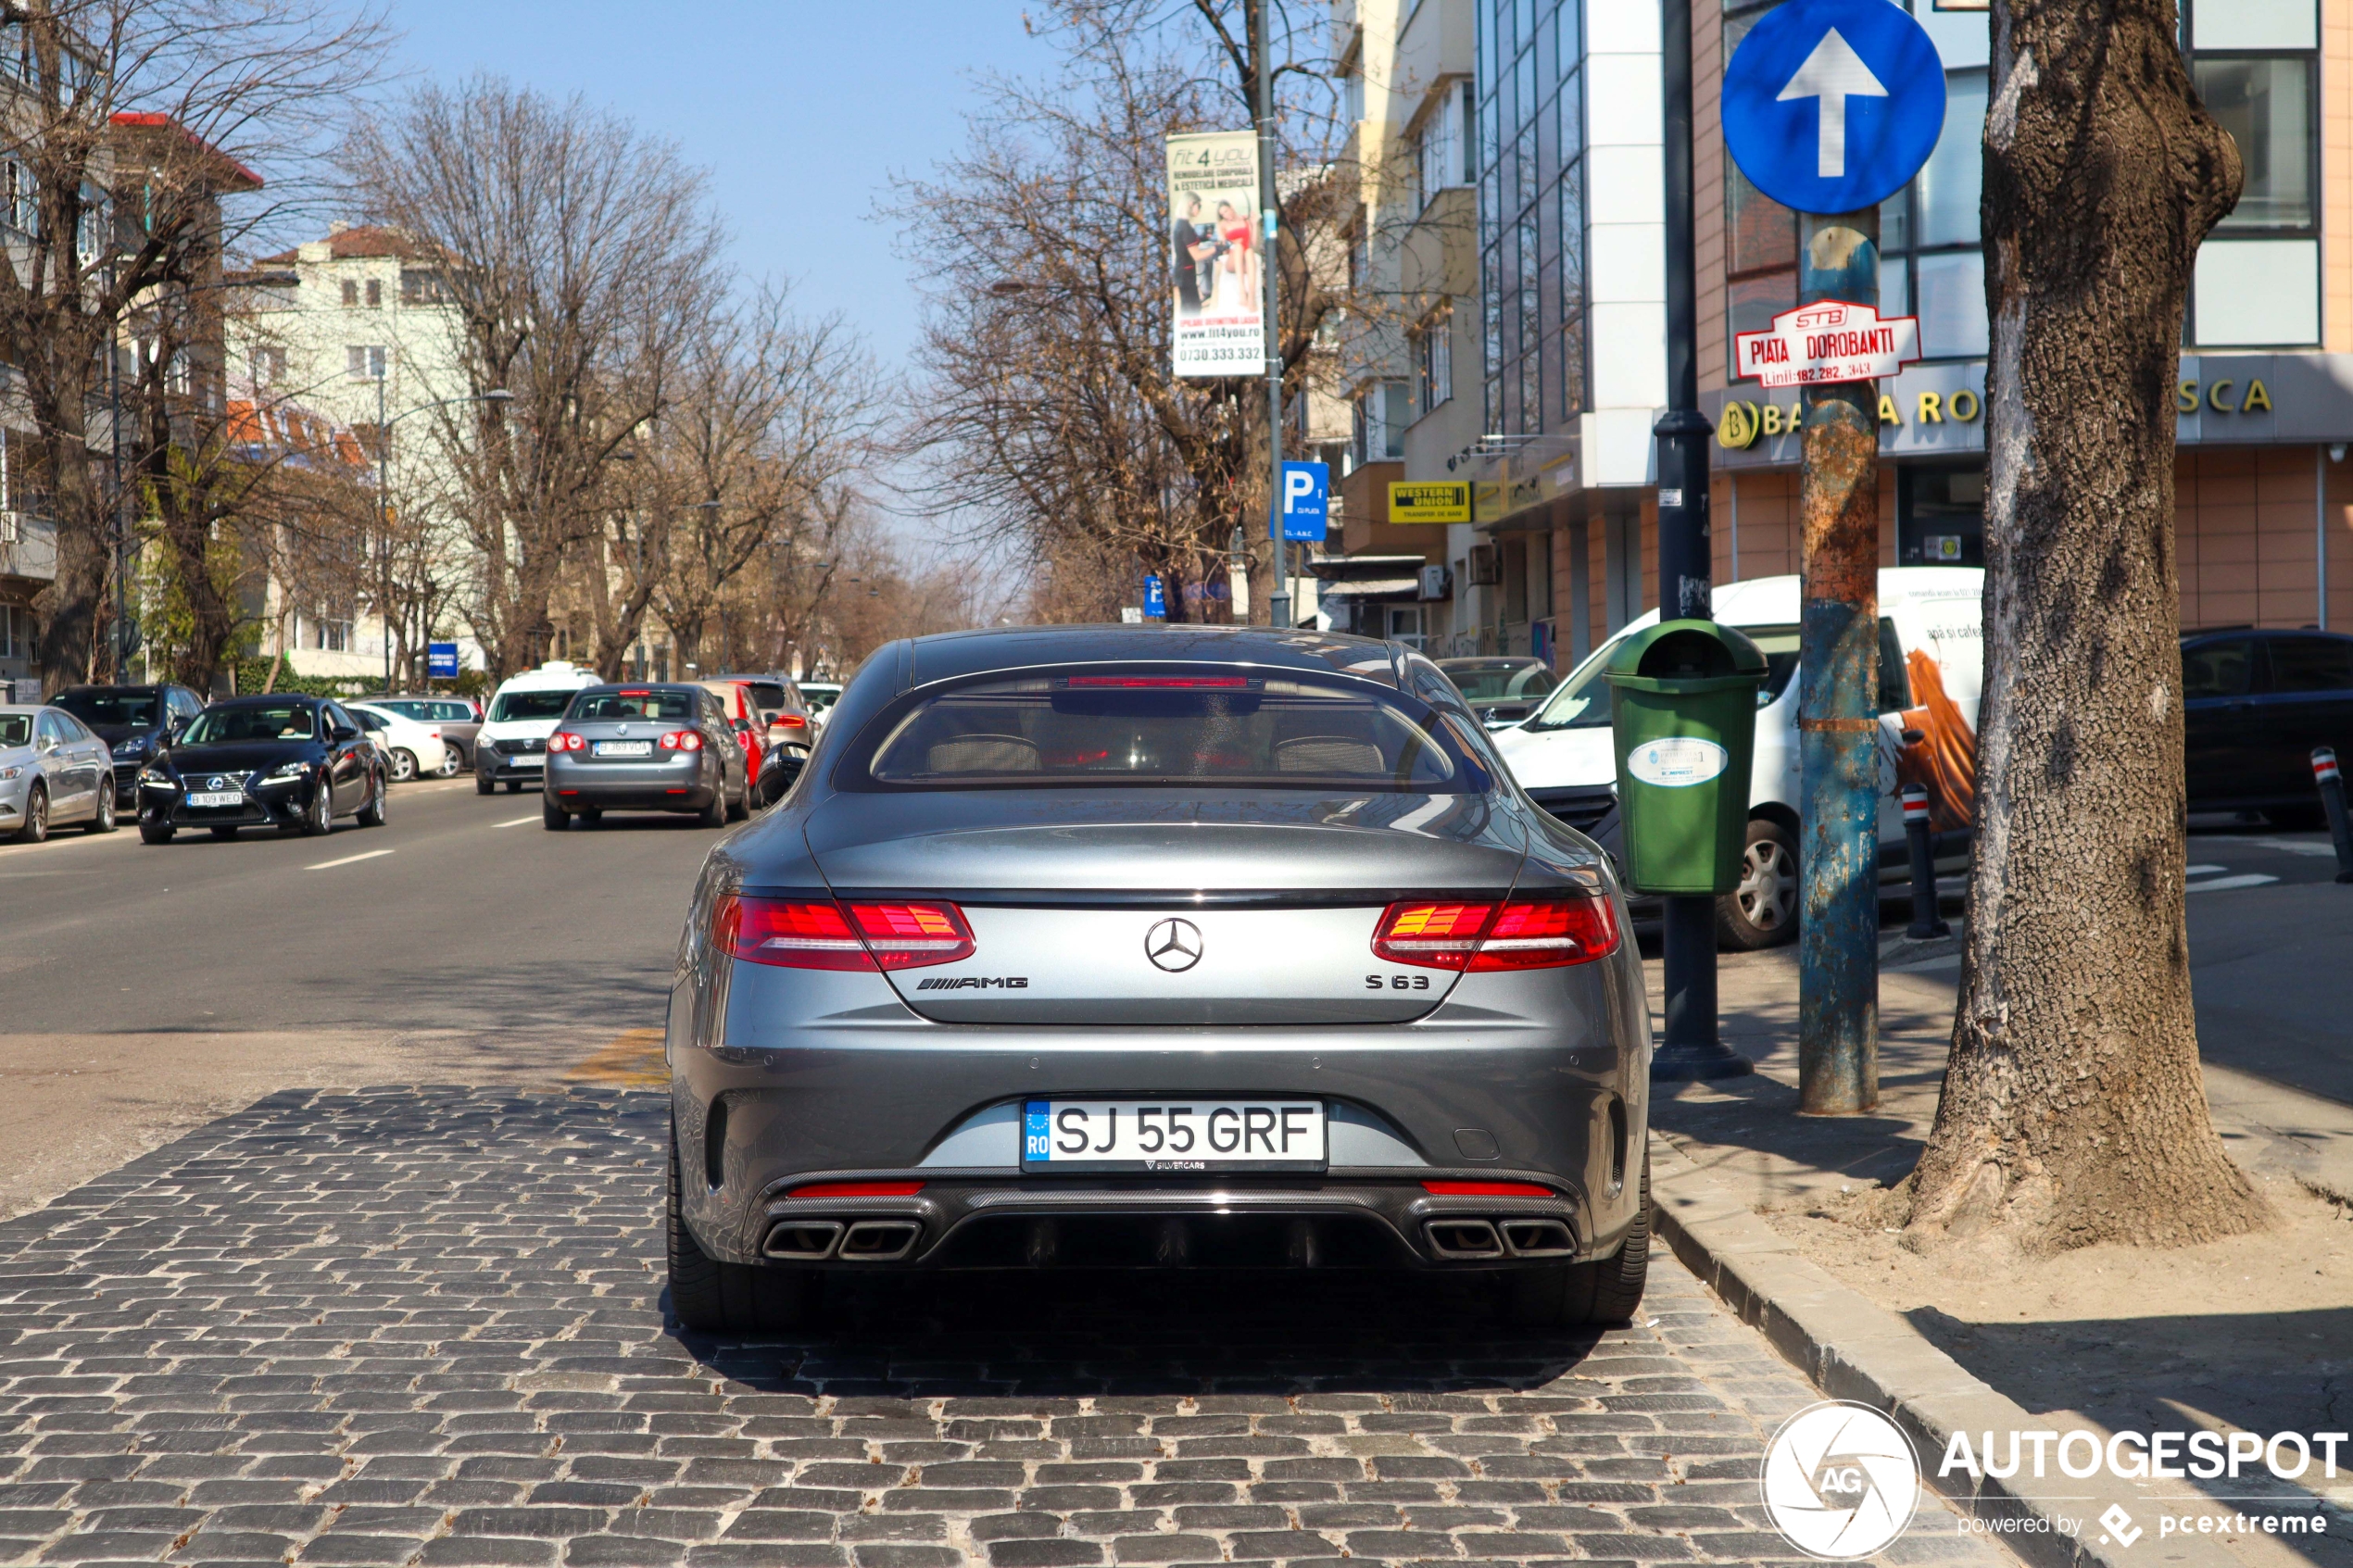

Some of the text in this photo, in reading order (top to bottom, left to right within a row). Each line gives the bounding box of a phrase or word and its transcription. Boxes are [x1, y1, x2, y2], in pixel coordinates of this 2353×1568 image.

[1173, 148, 1253, 167] fit 4 you
[1174, 169, 1214, 179] REMODELARE
[1795, 310, 1843, 328] STB
[1180, 327, 1260, 339] www.fit4you.ro
[1180, 347, 1260, 361] 0730.333.332
[1284, 470, 1314, 513] P
[1396, 487, 1453, 497] WESTERN
[1414, 496, 1453, 506] UNION
[1927, 624, 1945, 641] apă
[192, 794, 240, 804] B 109 WEO
[955, 977, 1027, 988] AMG
[1365, 975, 1429, 989] S 63
[1056, 1108, 1314, 1153] SJ 55 GRF
[1027, 1135, 1049, 1154] RO
[1157, 1161, 1205, 1170] SILVERCARS
